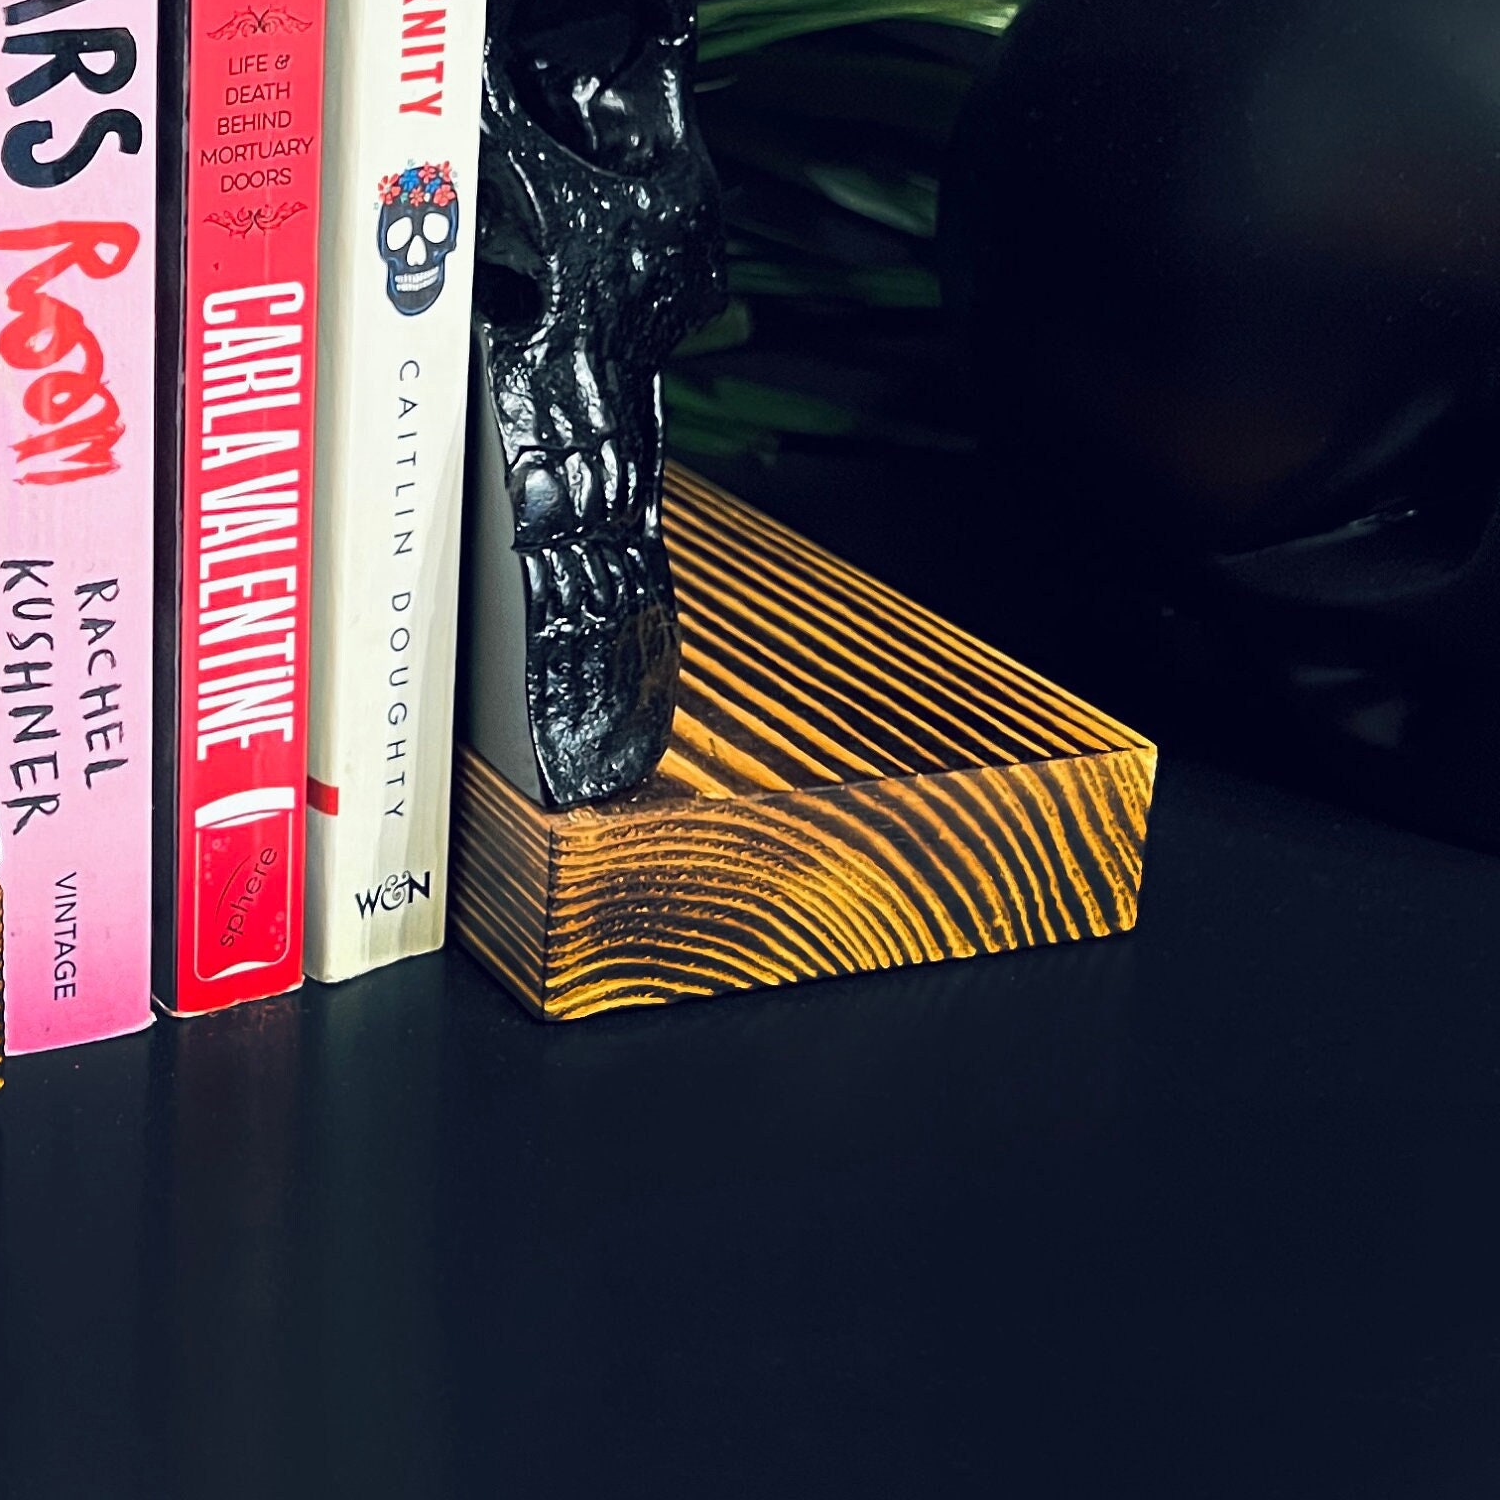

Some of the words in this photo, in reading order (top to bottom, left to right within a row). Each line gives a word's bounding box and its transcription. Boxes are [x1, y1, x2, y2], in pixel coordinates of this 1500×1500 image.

[216, 110, 292, 136] BEHIND
[225, 81, 291, 106] DEATH
[228, 53, 269, 76] LIFE
[274, 53, 291, 71] &
[200, 136, 315, 168] MORTUARY
[220, 167, 292, 193] DOORS
[201, 280, 305, 472] CARLA
[392, 358, 421, 558] CAITLIN
[196, 468, 299, 762] VALENTINE
[0, 558, 62, 837] KUSHNER
[74, 577, 130, 790] RACHEL
[384, 590, 413, 819] DOUGHTY
[53, 870, 78, 1002] VINTAGE
[219, 846, 278, 949] sphere
[354, 869, 431, 920] W&N
